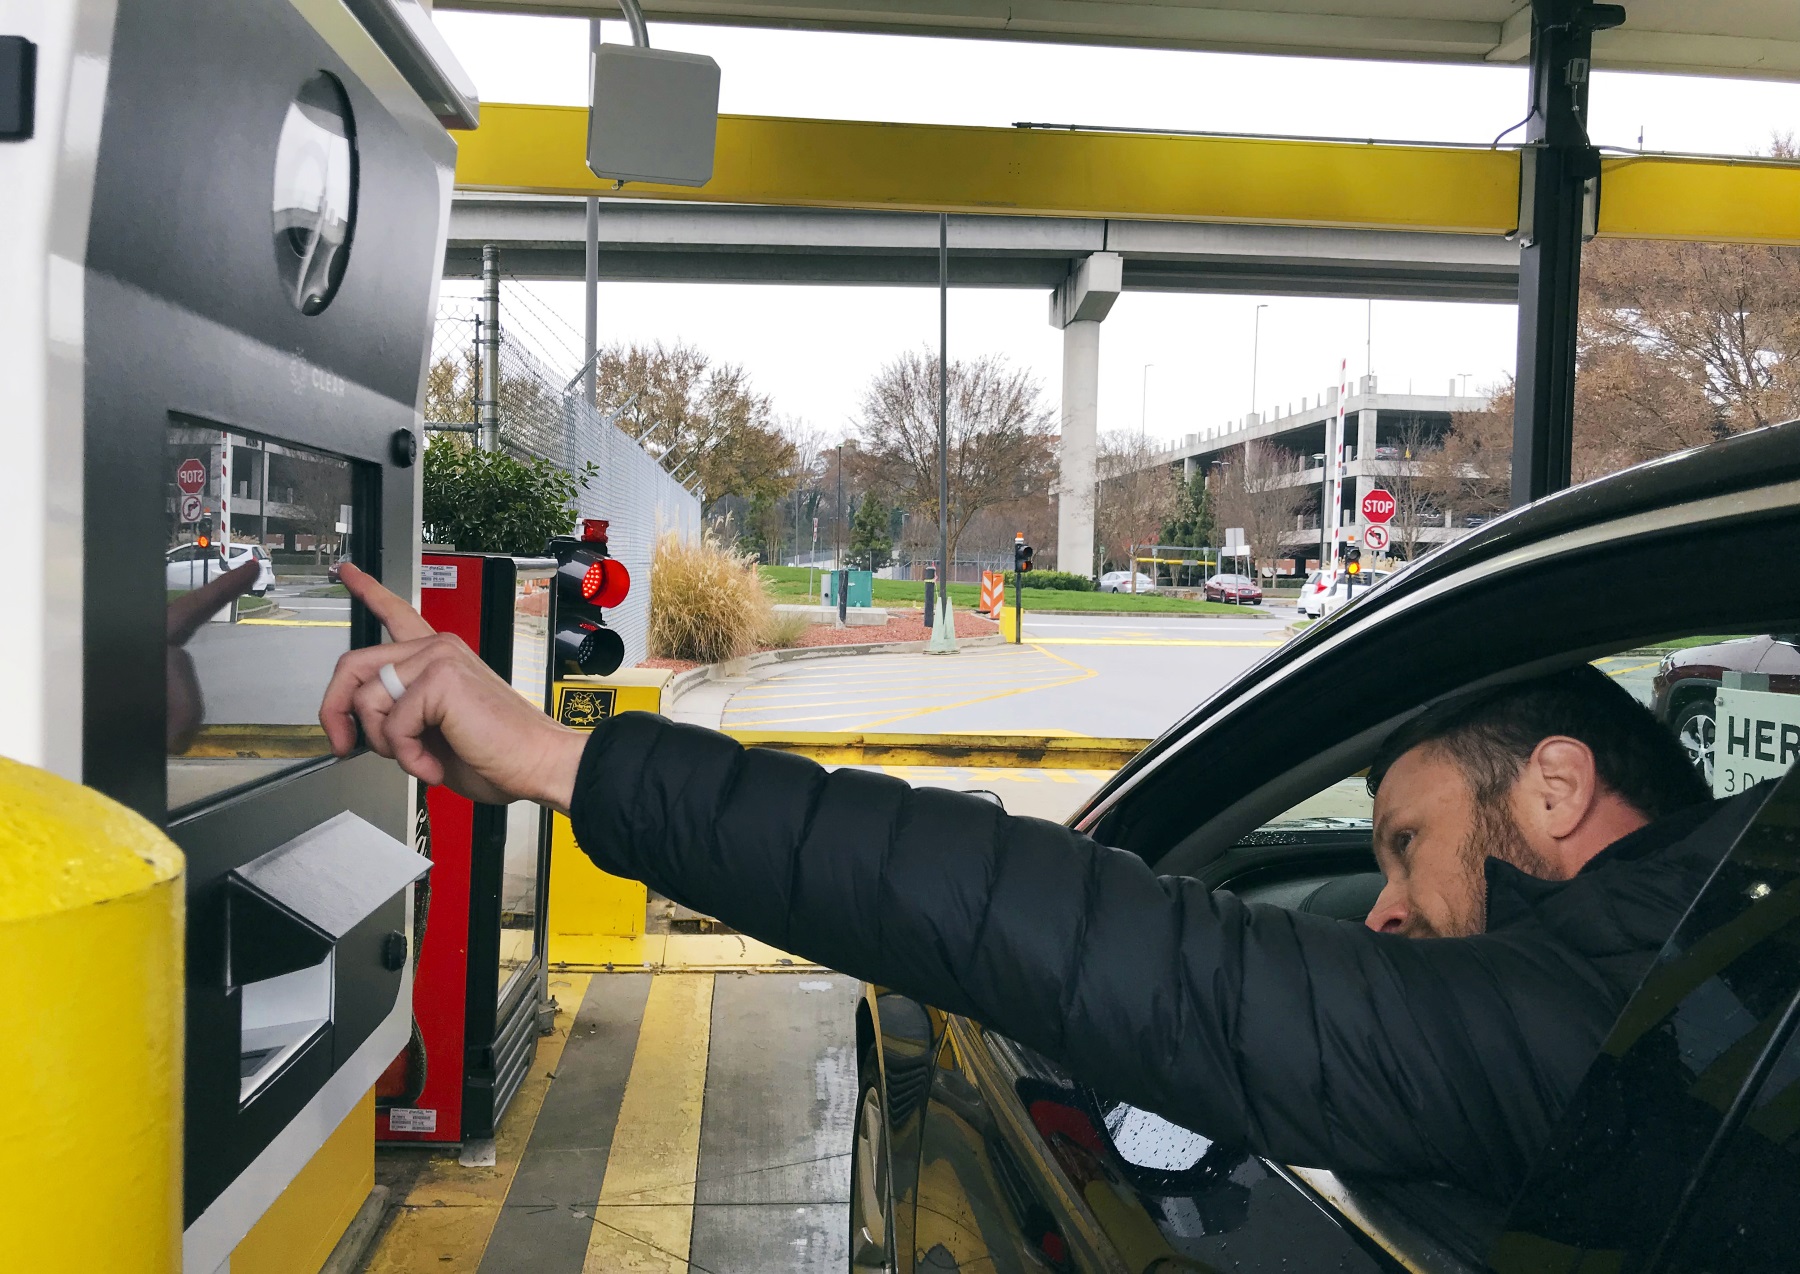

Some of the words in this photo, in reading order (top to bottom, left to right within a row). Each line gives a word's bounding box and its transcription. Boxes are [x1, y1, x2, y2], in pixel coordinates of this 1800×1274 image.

[312, 367, 345, 397] CLEAR
[1363, 499, 1393, 514] STOP
[1724, 768, 1735, 792] 3
